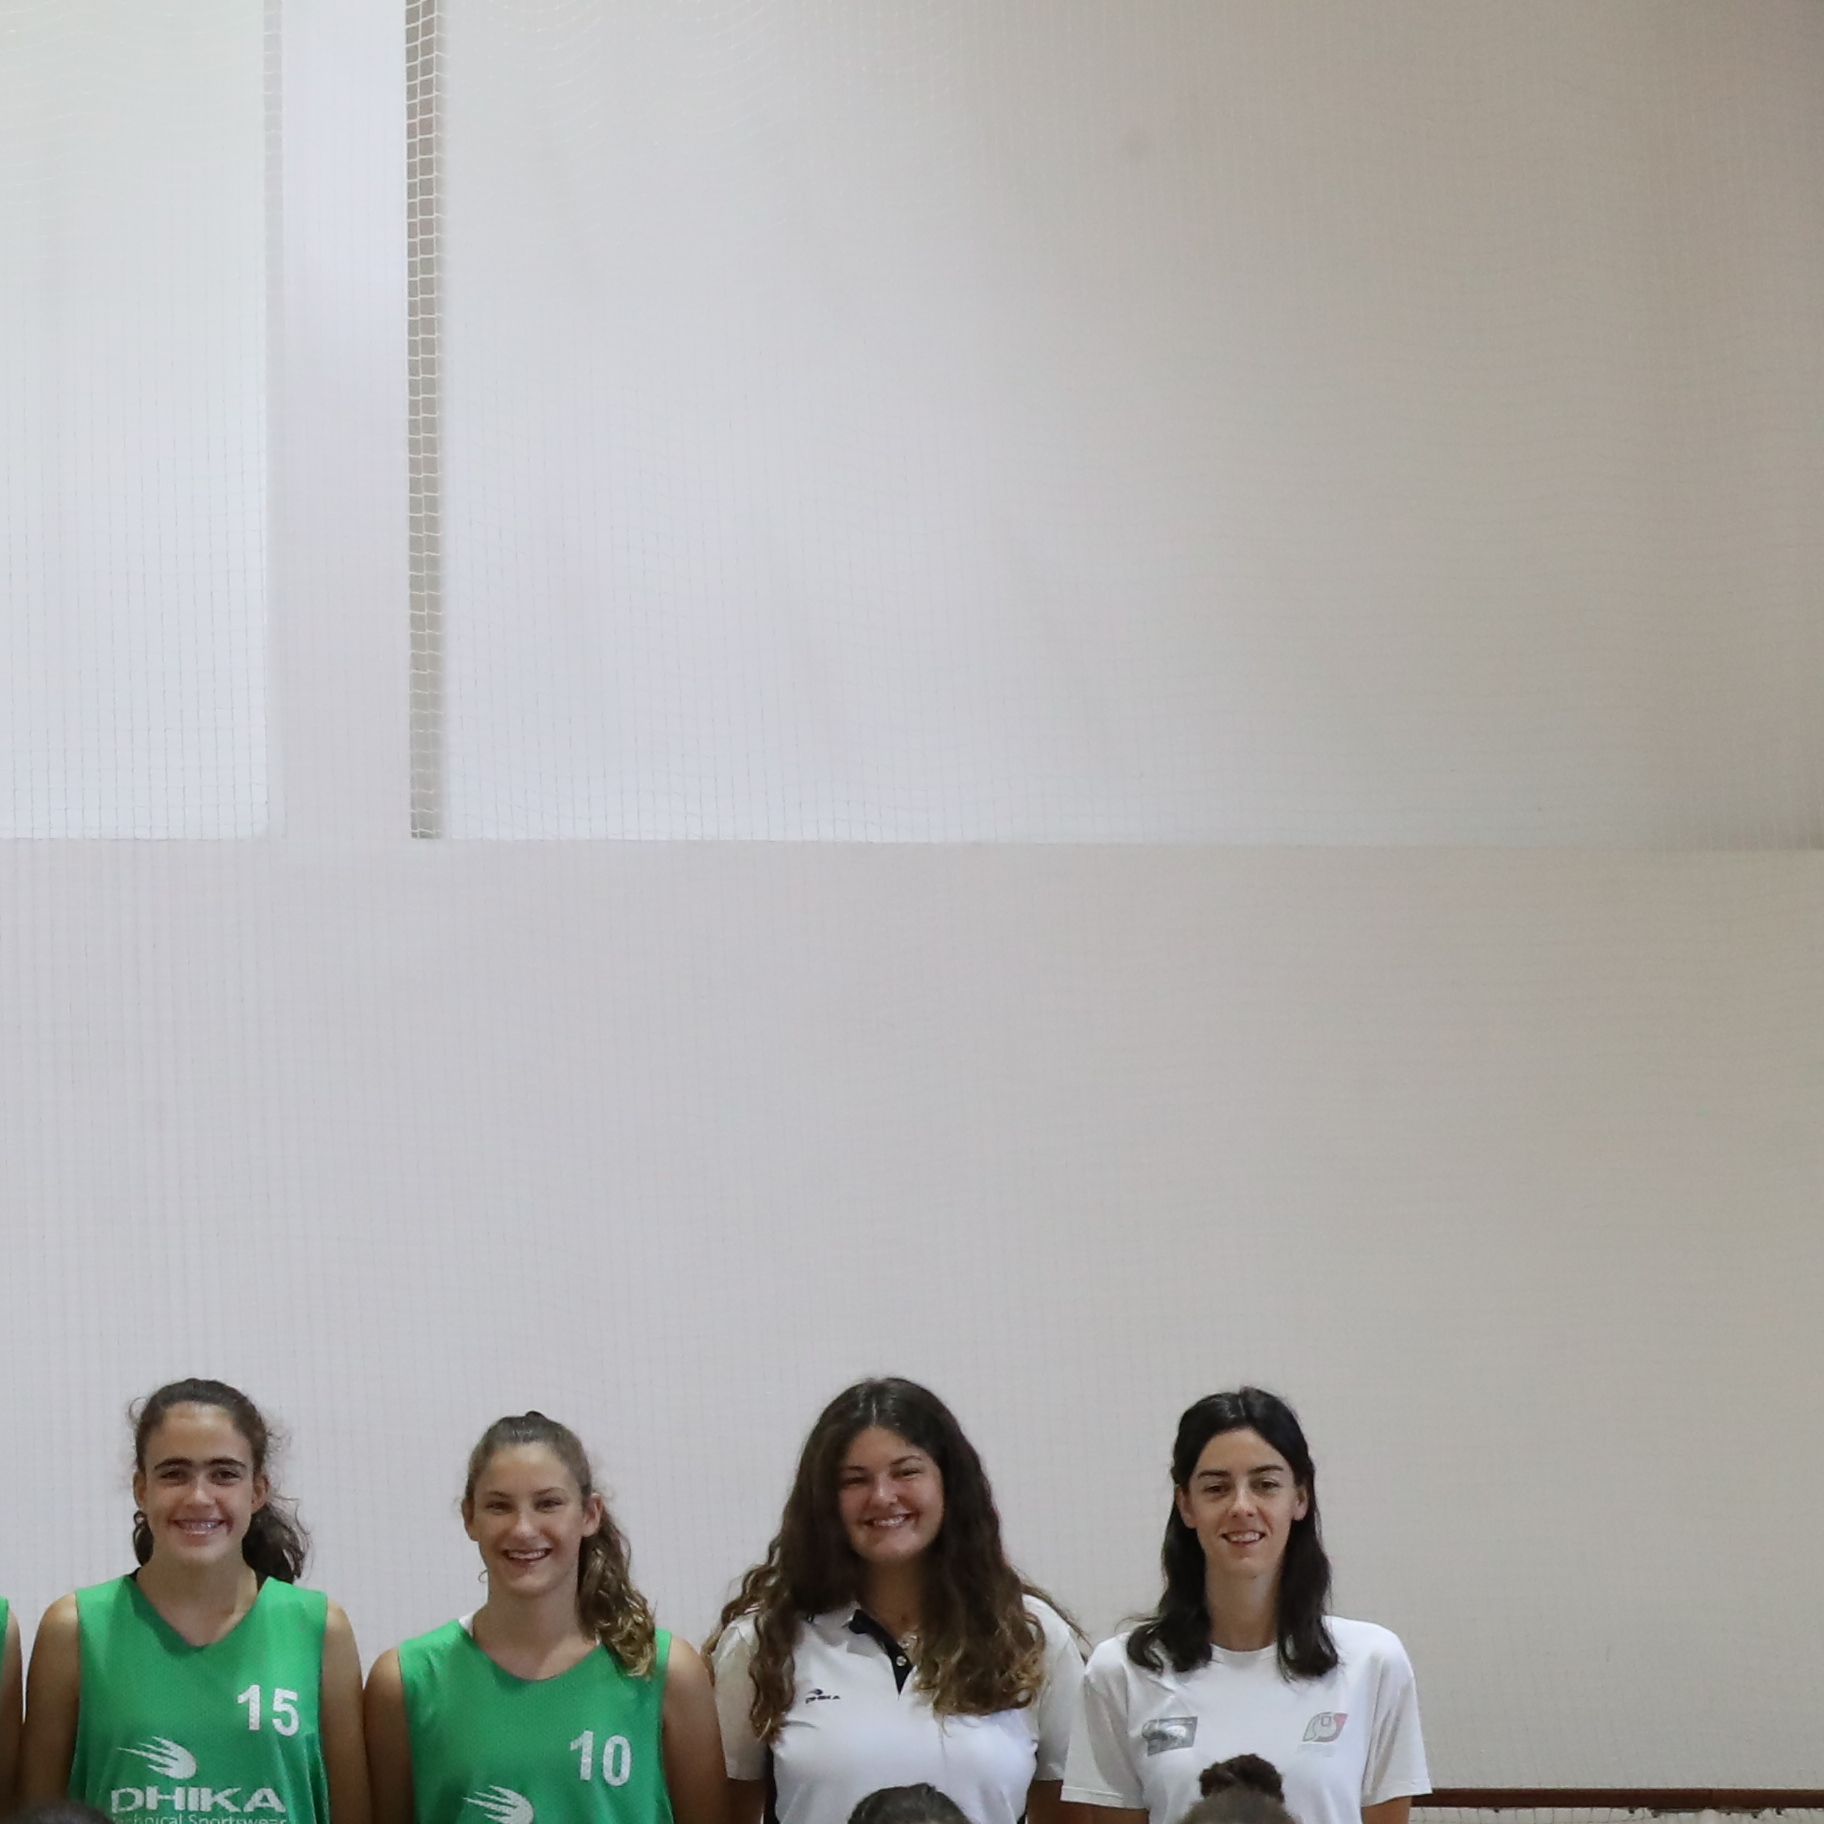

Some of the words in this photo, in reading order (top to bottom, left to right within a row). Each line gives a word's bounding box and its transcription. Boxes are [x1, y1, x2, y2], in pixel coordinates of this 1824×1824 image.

[237, 1684, 299, 1736] 15
[569, 1730, 632, 1786] 10
[110, 1786, 287, 1813] DHIKA
